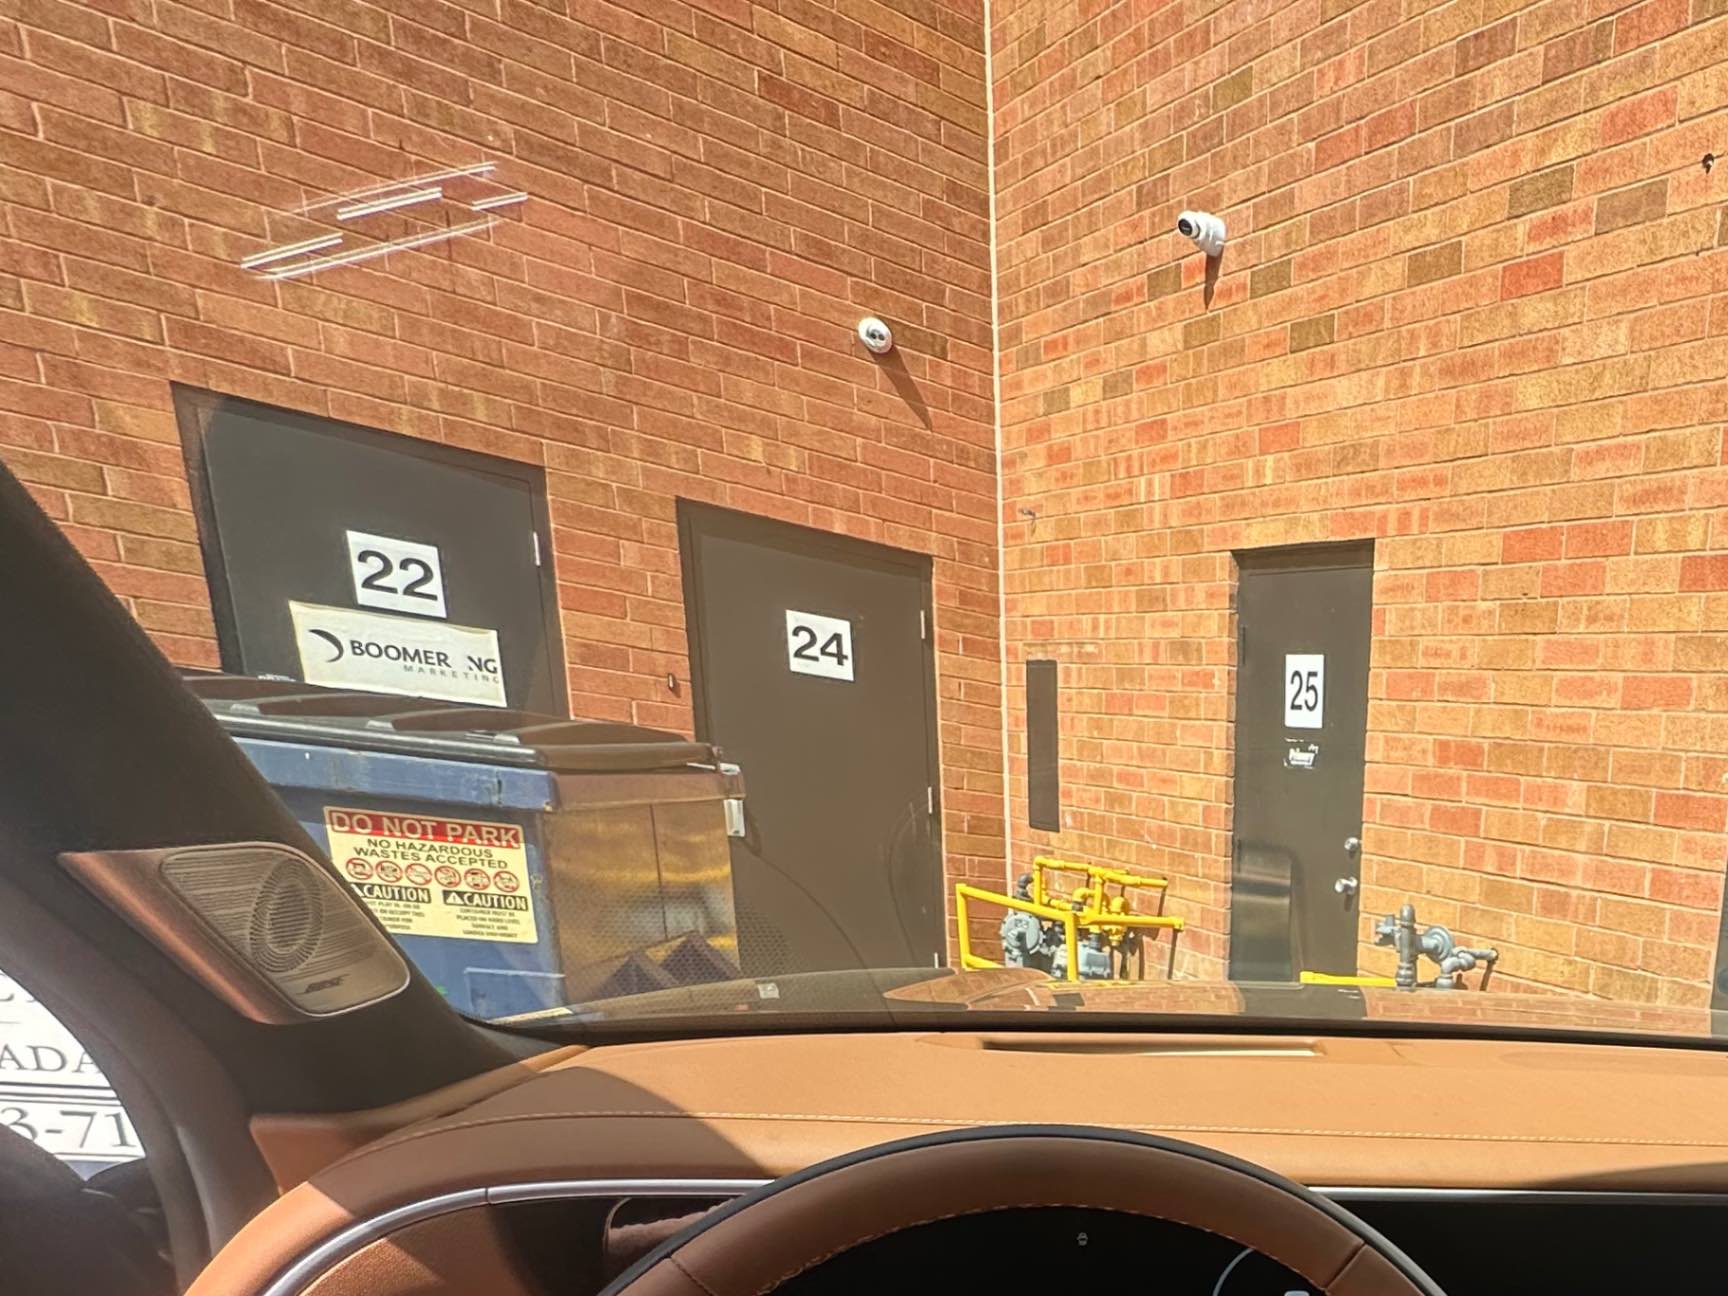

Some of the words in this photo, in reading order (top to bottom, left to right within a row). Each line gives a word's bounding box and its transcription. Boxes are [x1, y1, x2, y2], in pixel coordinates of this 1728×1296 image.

[357, 549, 438, 601] 22
[792, 625, 849, 666] 24
[1290, 670, 1319, 711] 25
[331, 811, 373, 834] DO
[382, 816, 439, 839] NOT
[445, 823, 520, 848] PARK
[354, 847, 421, 862] WASTES
[425, 853, 509, 870] ACCEPTED
[366, 838, 391, 849] NO
[395, 841, 493, 859] HAZARDOUS
[363, 884, 430, 903] CAUTION
[463, 892, 527, 911] CAUTION
